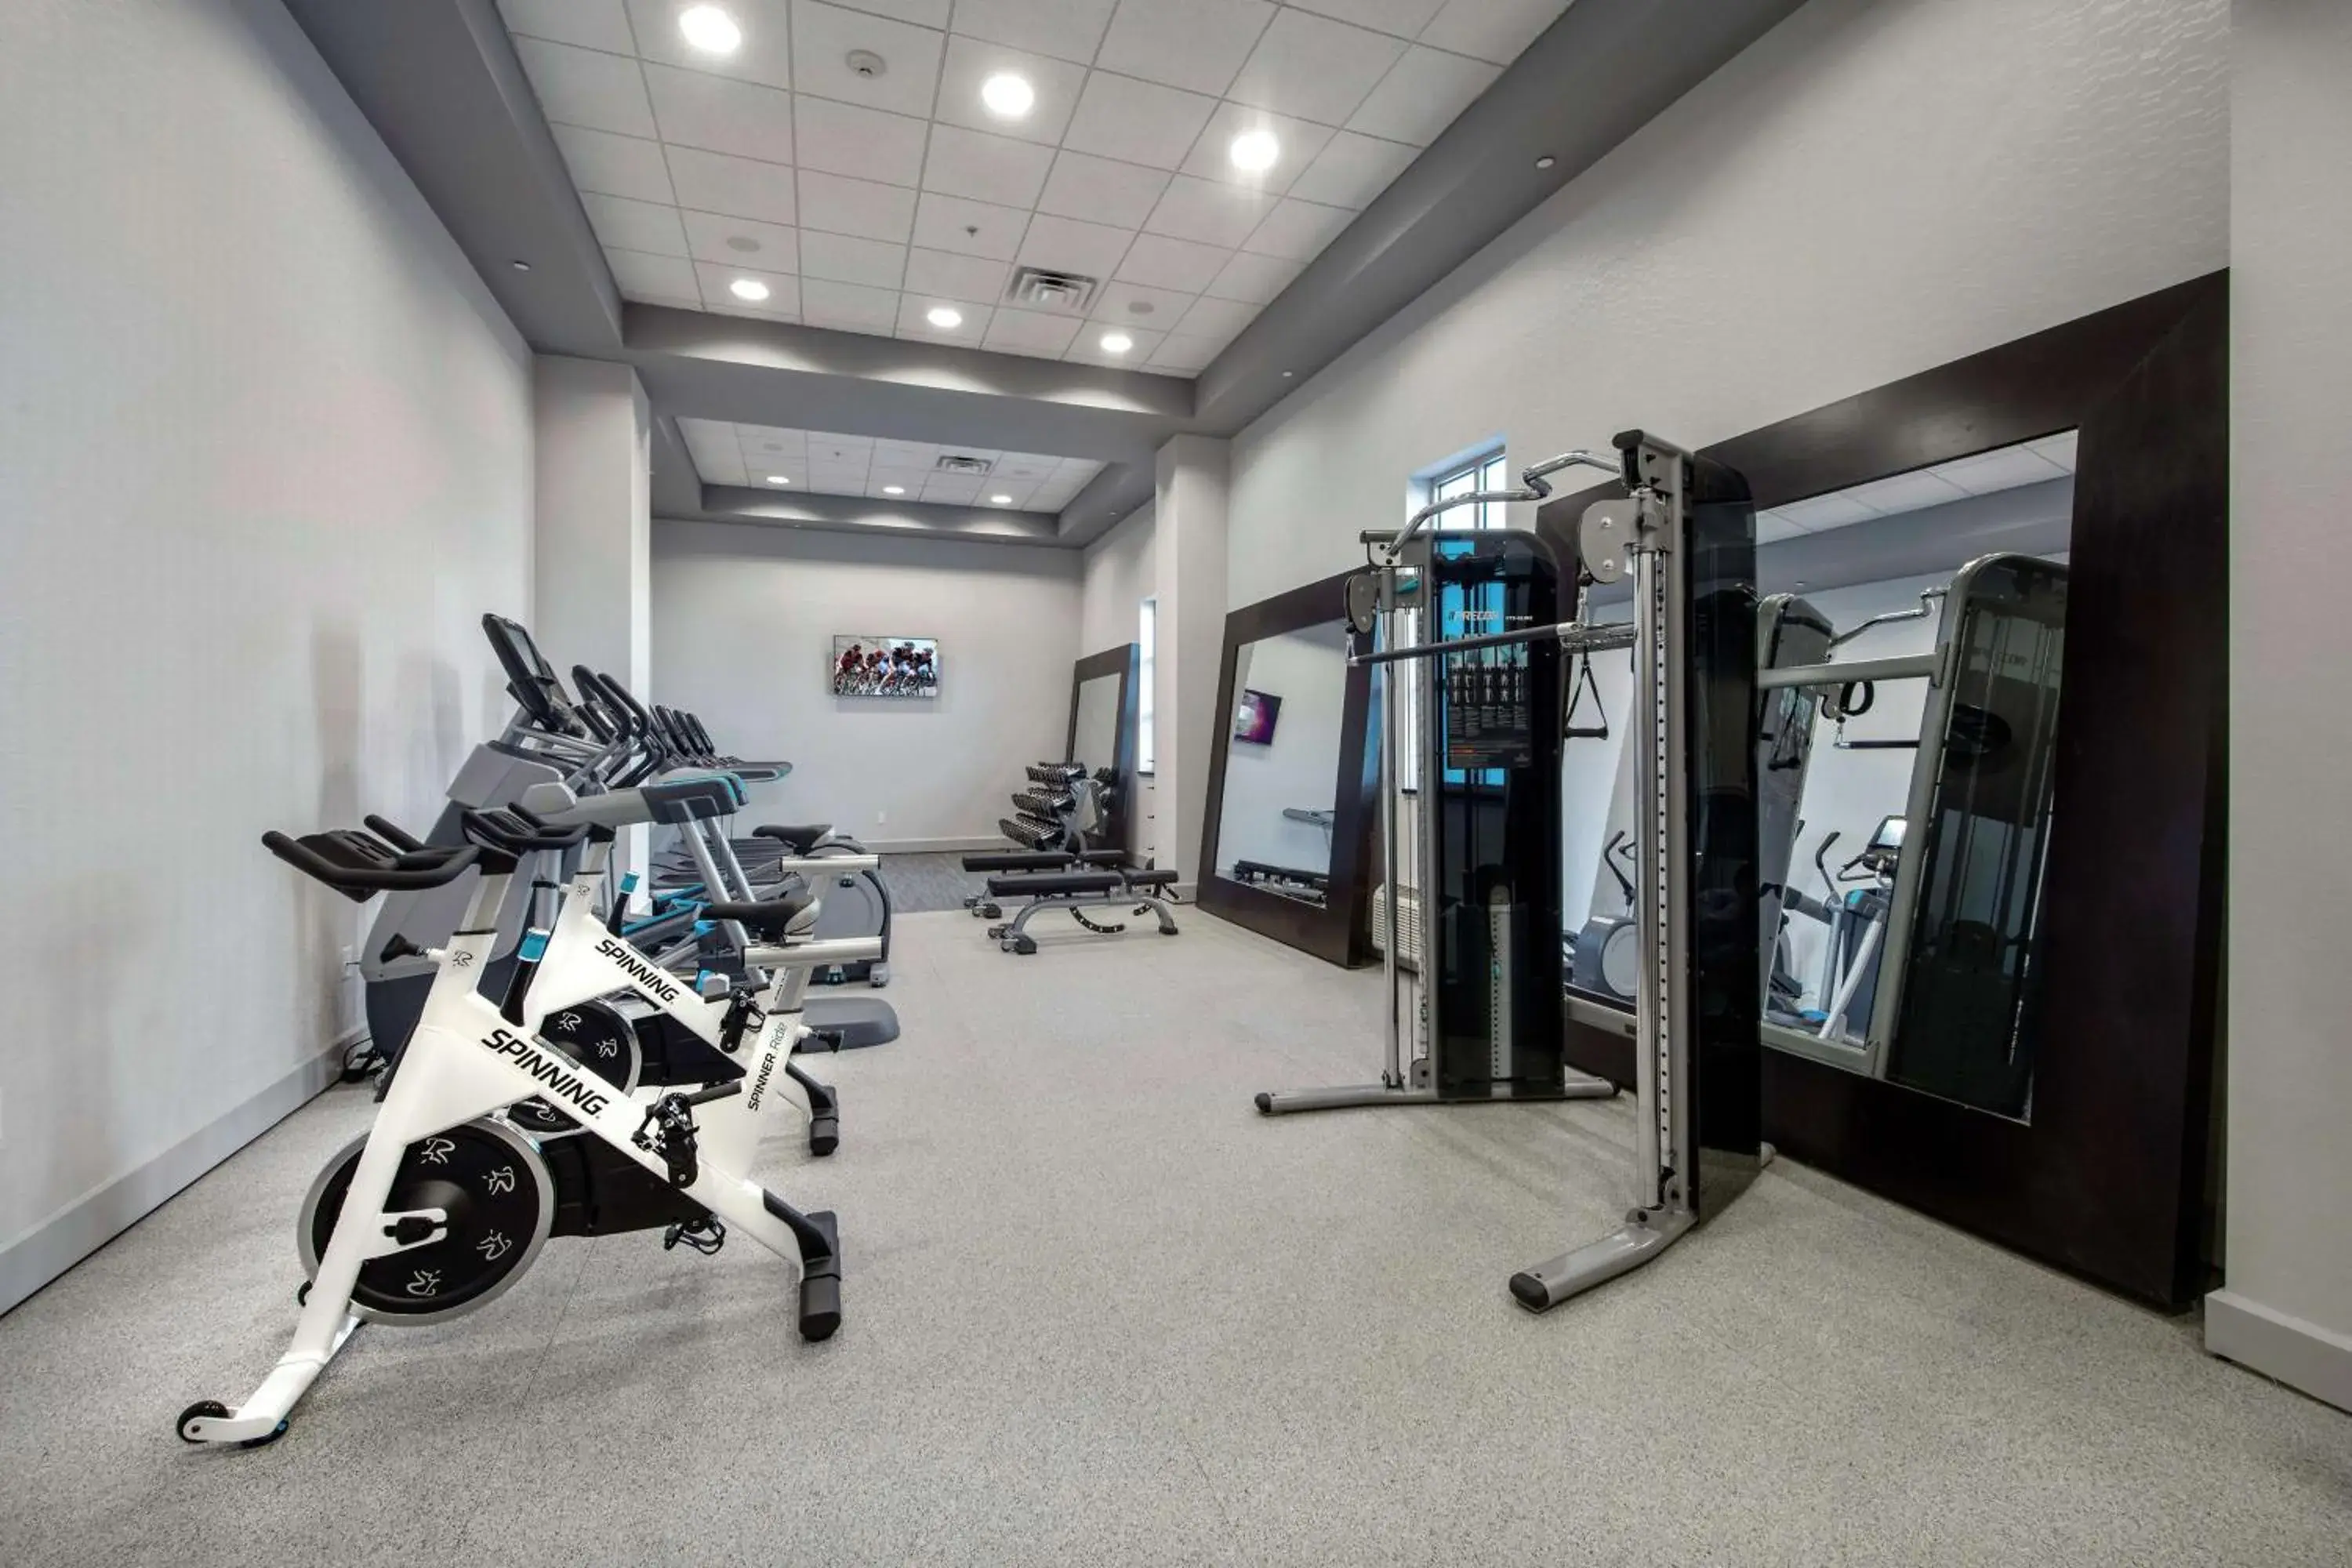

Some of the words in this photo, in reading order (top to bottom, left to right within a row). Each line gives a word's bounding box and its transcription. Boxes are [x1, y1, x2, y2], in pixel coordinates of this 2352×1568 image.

[594, 939, 680, 1003] SPINNING
[481, 1029, 610, 1116] SPINNING
[747, 1053, 776, 1112] SPINNER
[770, 1022, 788, 1051] Ride
